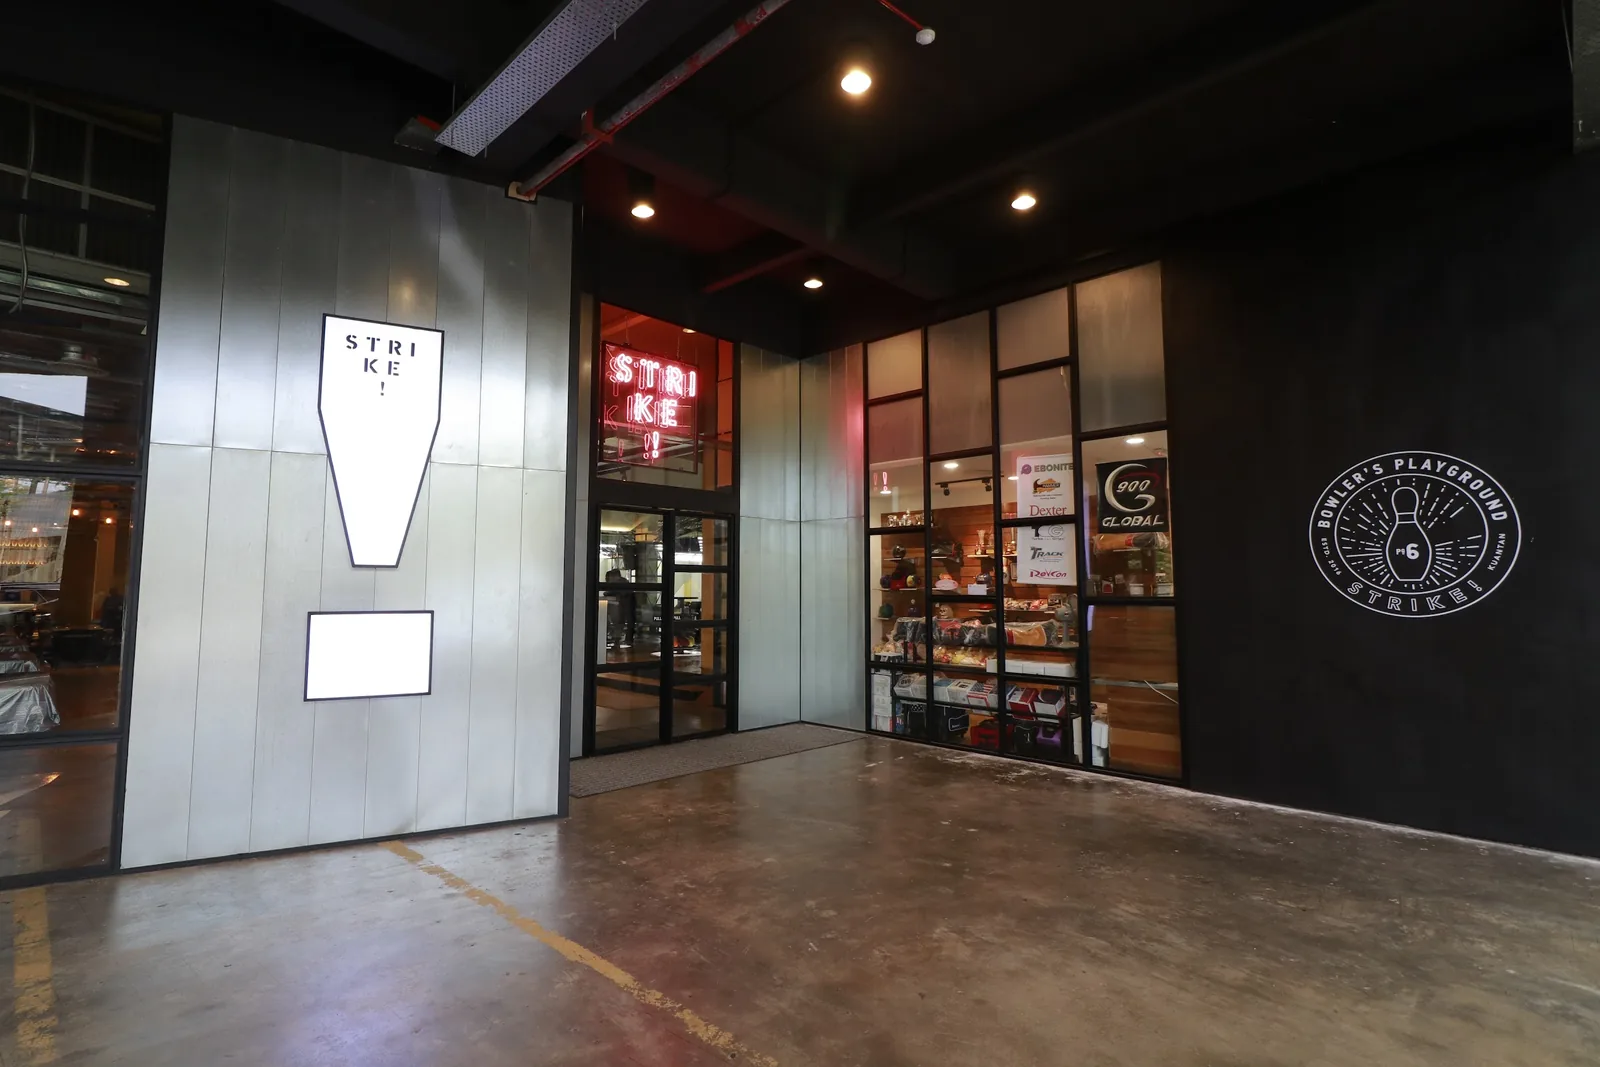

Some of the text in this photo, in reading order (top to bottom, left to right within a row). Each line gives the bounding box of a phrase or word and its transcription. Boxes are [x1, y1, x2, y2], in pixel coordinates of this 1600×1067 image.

[346, 334, 416, 357] STRI
[364, 358, 400, 376] KE
[615, 353, 697, 397] STRI
[634, 392, 678, 427] KE
[1034, 463, 1074, 472] EBONITE
[1116, 480, 1151, 493] 900
[1317, 458, 1508, 529] BOWLER'S PLAYGROUND
[1029, 505, 1067, 516] Dexter
[1102, 515, 1164, 527] GLOBAL
[1030, 546, 1064, 560] TRACK
[1321, 538, 1341, 576] ESTD. 2016
[1487, 533, 1506, 571] KUANTAN
[1347, 580, 1483, 613] STRIKE!
